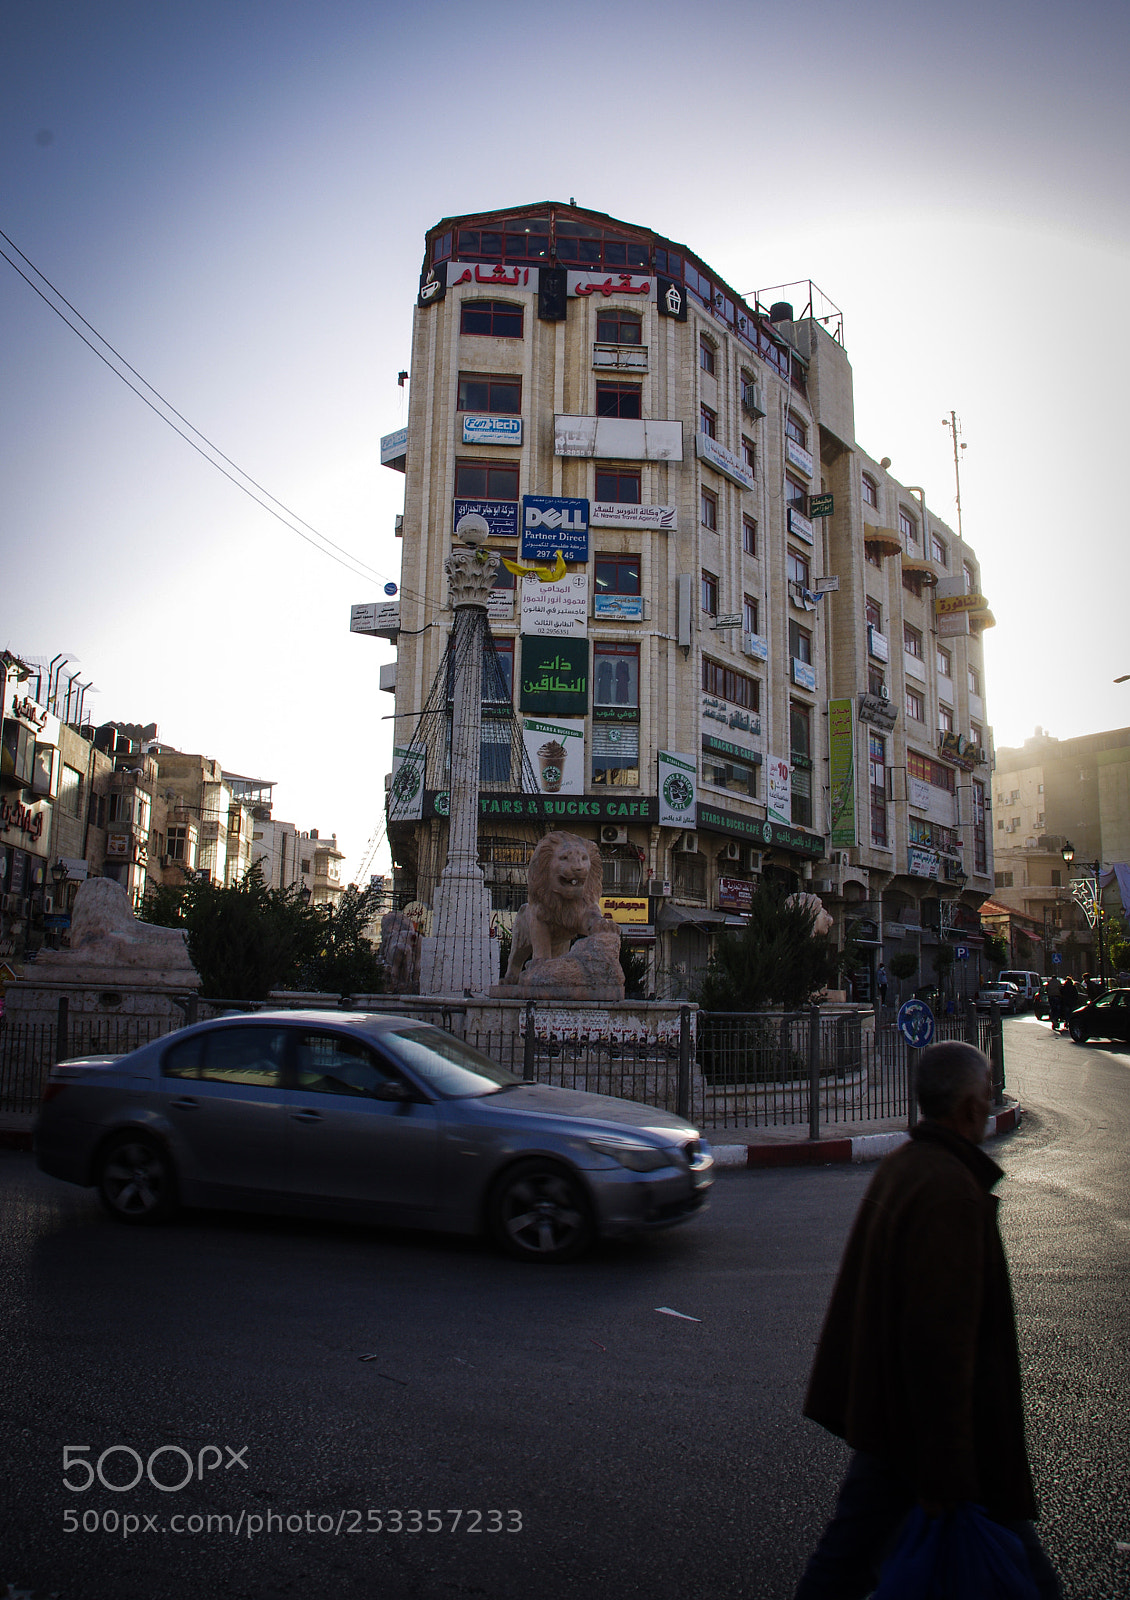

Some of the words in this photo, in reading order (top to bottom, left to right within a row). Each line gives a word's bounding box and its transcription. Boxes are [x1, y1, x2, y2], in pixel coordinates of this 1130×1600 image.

[453, 264, 529, 286] الشام
[575, 274, 650, 296] مقهى
[467, 418, 487, 428] Fun
[490, 419, 518, 431] Tech
[525, 507, 587, 531] DELL
[525, 531, 557, 540] Partner
[559, 532, 586, 542] Direct
[536, 550, 550, 558] 297
[539, 585, 571, 594] المحامي
[562, 598, 586, 606] محمود
[940, 596, 981, 612] النافورة
[522, 605, 546, 614] القانون
[546, 606, 557, 615] في
[538, 655, 572, 671] ذات
[523, 674, 586, 694] النطاقين
[596, 708, 615, 718] شوب
[616, 710, 637, 720] كوفي
[536, 724, 553, 733] STARS
[710, 737, 733, 753] SNACKS
[735, 746, 739, 756] &
[778, 762, 788, 781] 10
[478, 799, 523, 814] TARS
[528, 801, 539, 814] &
[544, 801, 601, 816] BUCKS
[701, 811, 720, 826] STARS
[721, 815, 725, 826] &
[726, 817, 744, 832] BUCKS
[604, 899, 646, 911] مجوهرات
[957, 947, 966, 958] P
